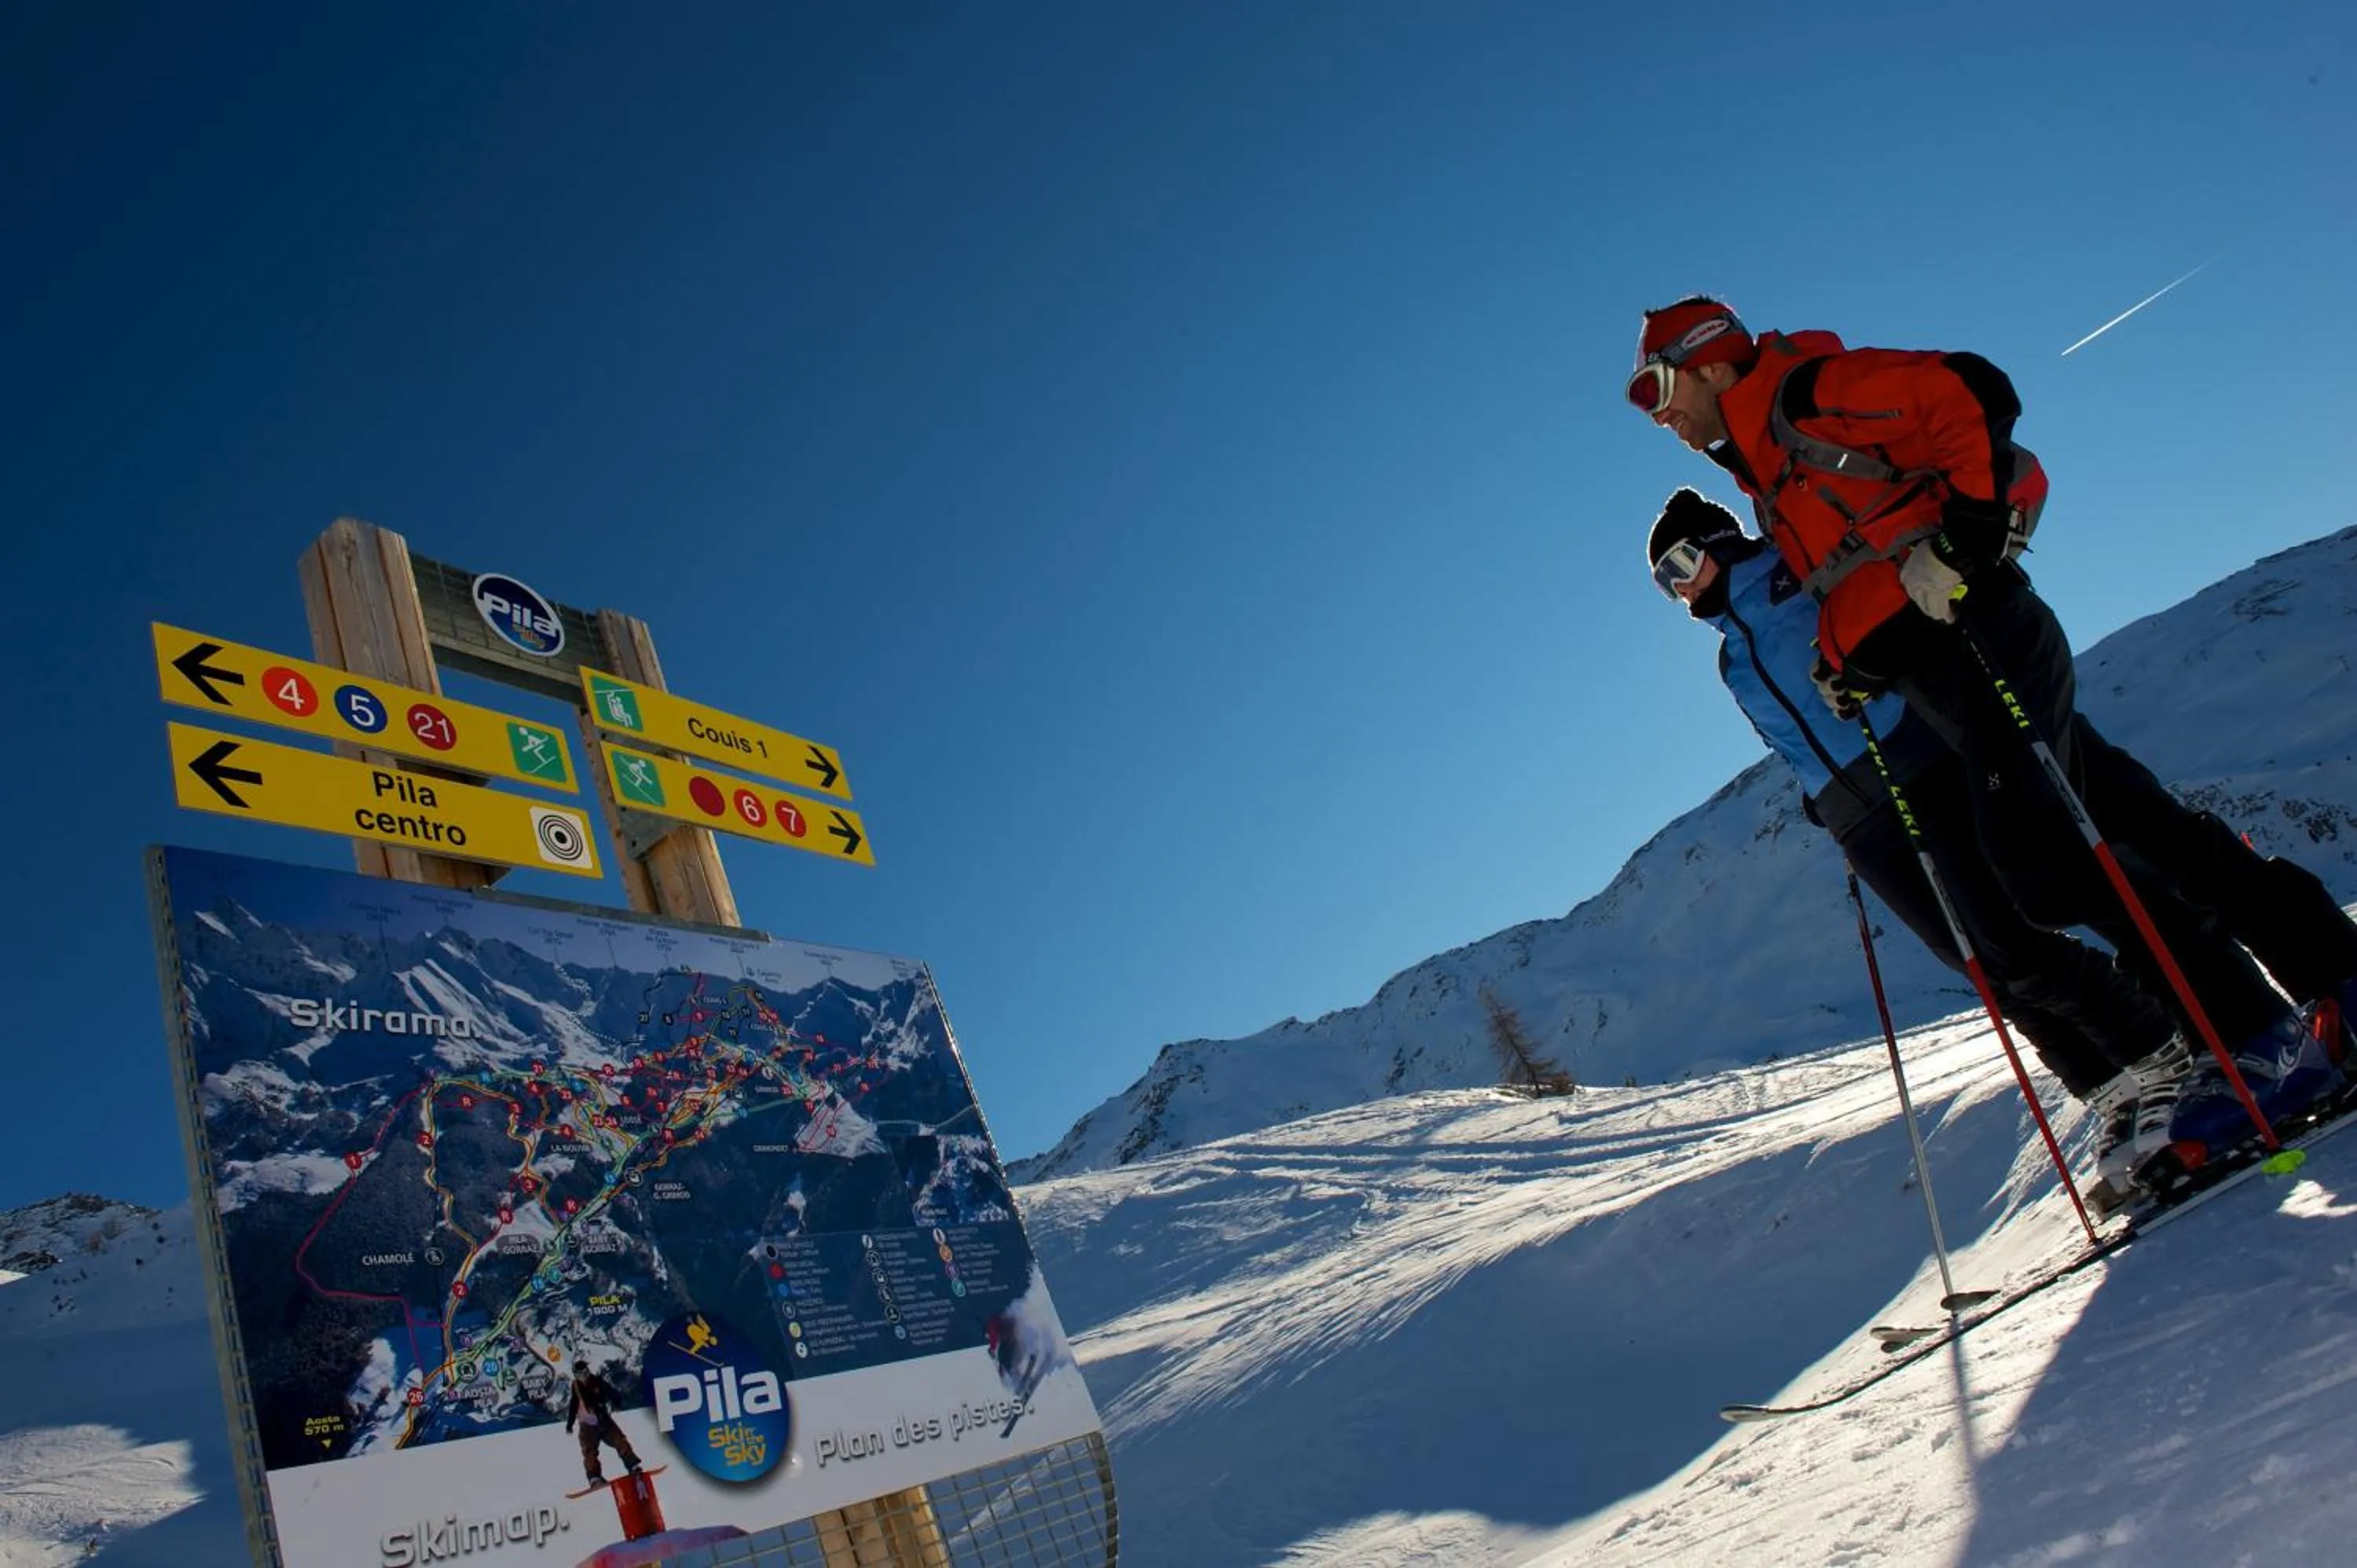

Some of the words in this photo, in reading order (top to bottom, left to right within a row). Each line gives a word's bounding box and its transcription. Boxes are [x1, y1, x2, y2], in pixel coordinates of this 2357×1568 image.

[481, 591, 559, 639] Pila
[277, 678, 305, 711] 4
[349, 694, 376, 728] 5
[413, 712, 453, 744] 21
[1994, 680, 2030, 728] LEKI
[687, 716, 751, 755] Couis
[757, 740, 768, 758] 1
[372, 771, 438, 808] Pila
[354, 808, 467, 848] centro
[741, 795, 760, 822] 6
[784, 808, 799, 833] 7
[653, 1365, 783, 1434] Pila
[304, 1423, 330, 1437] 570
[305, 1414, 341, 1427] Aosta
[708, 1420, 743, 1449] Ski
[815, 1426, 885, 1467] Plan
[893, 1413, 942, 1448] des
[724, 1442, 768, 1467] Sky
